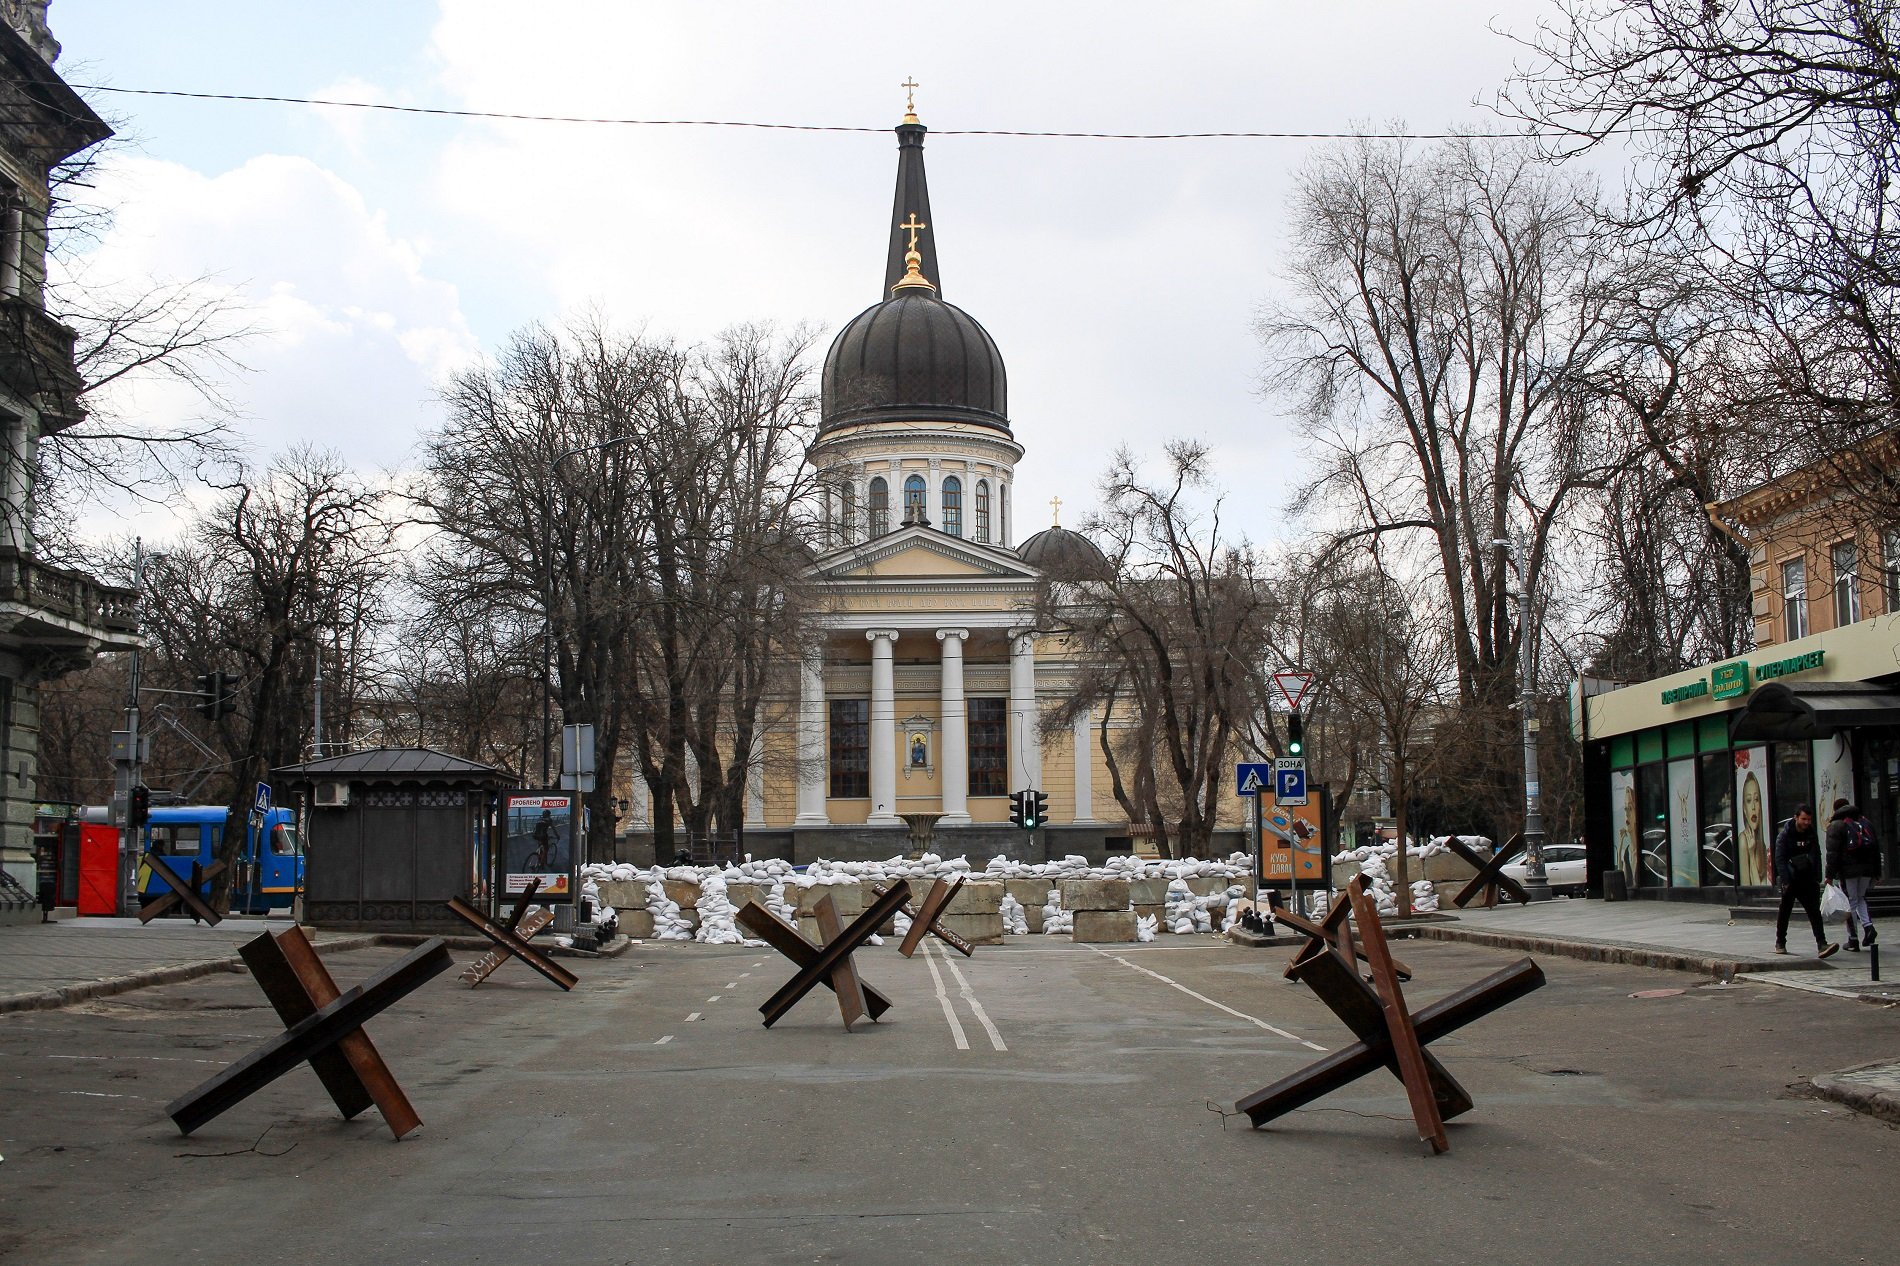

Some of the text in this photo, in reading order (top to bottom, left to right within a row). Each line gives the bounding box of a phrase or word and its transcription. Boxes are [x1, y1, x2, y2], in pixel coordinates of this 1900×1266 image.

[1755, 650, 1826, 682] СУПЕРМАРКЕТ
[1278, 760, 1303, 769] ЗОНА
[1284, 774, 1299, 793] P
